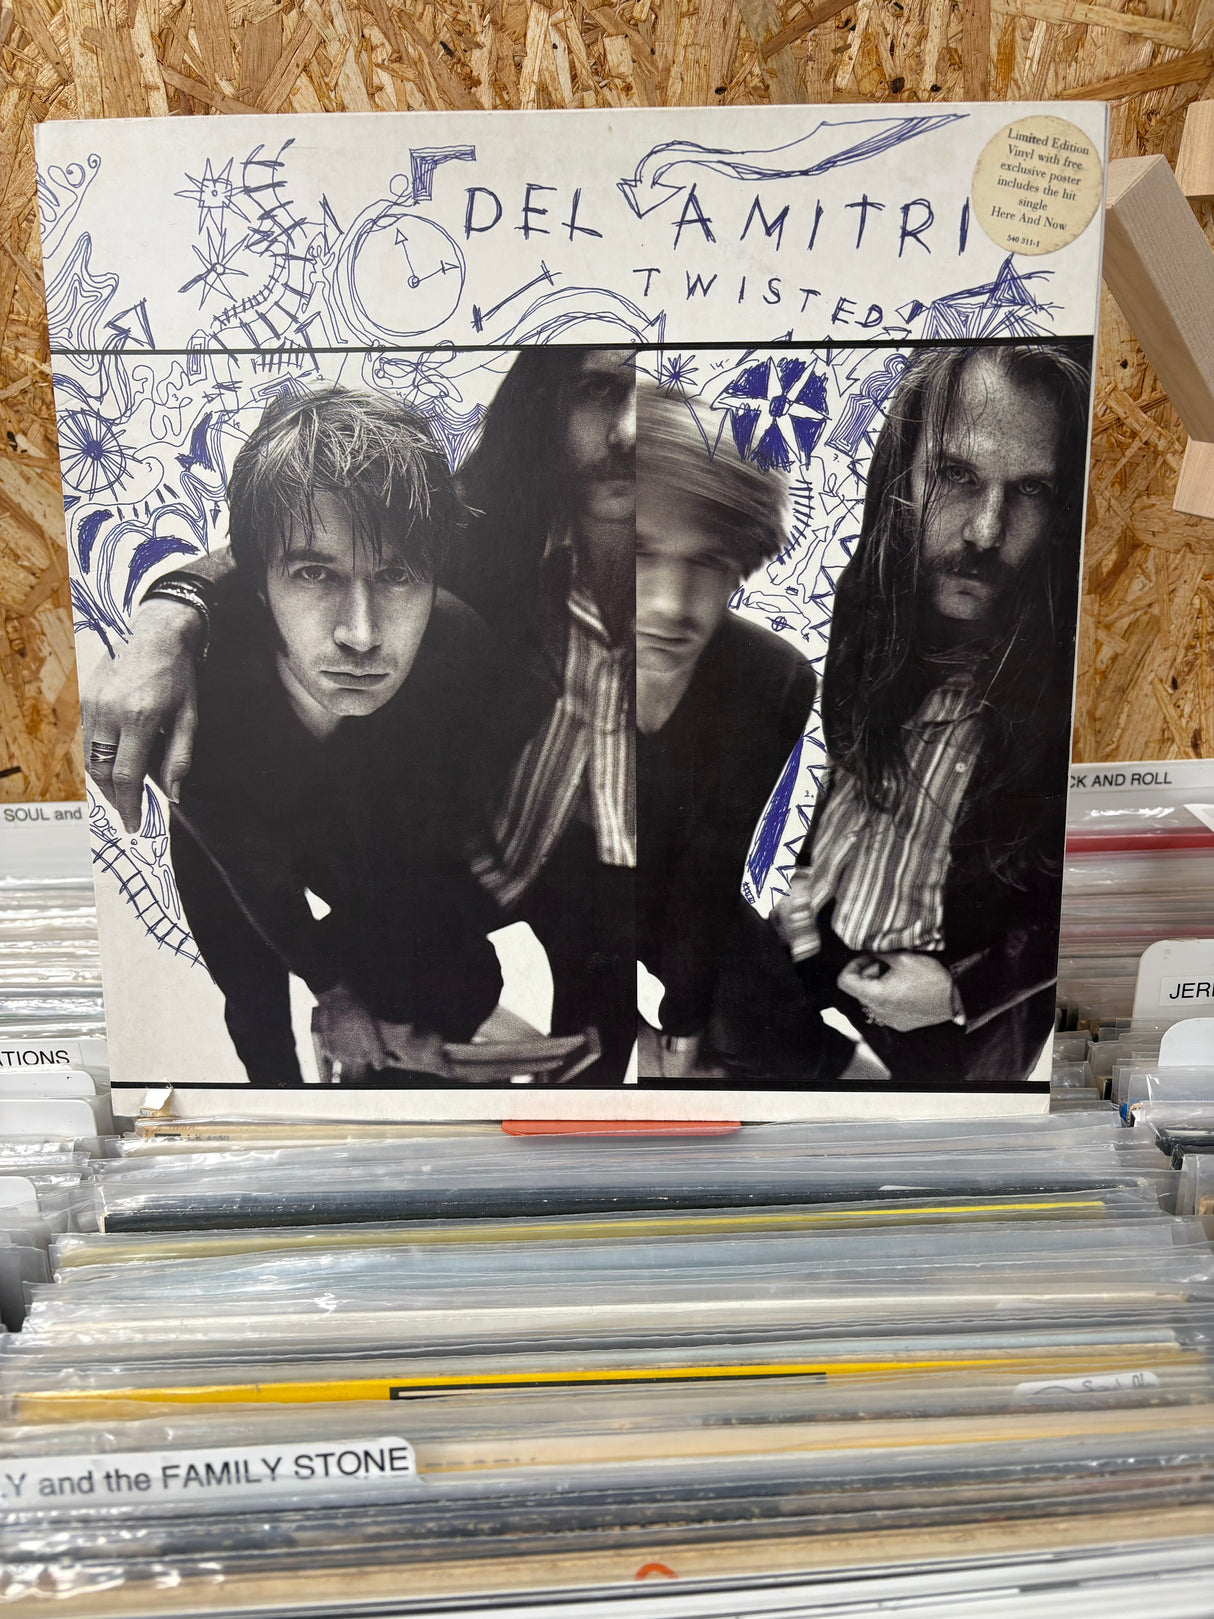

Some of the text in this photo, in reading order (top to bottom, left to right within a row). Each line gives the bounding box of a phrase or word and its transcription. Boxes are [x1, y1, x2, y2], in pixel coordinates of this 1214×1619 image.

[1007, 128, 1089, 155] Limited Edition
[1008, 144, 1083, 170] Vinyl with free
[1000, 161, 1081, 186] exclusive poster
[997, 175, 1077, 201] includes the hit
[1018, 197, 1048, 212] single
[465, 183, 970, 257] DEL AMITRI
[991, 205, 1067, 231] Here And Now
[1006, 234, 1040, 247] 540 311-1
[632, 268, 884, 328] TWISTED
[1091, 773, 1126, 787] AND
[1130, 771, 1172, 786] ROLL
[4, 806, 82, 822] SOUL and
[1169, 982, 1214, 999] JER
[0, 1050, 70, 1066] TIONS
[0, 1447, 410, 1497] Y and the FAMILY STONE
